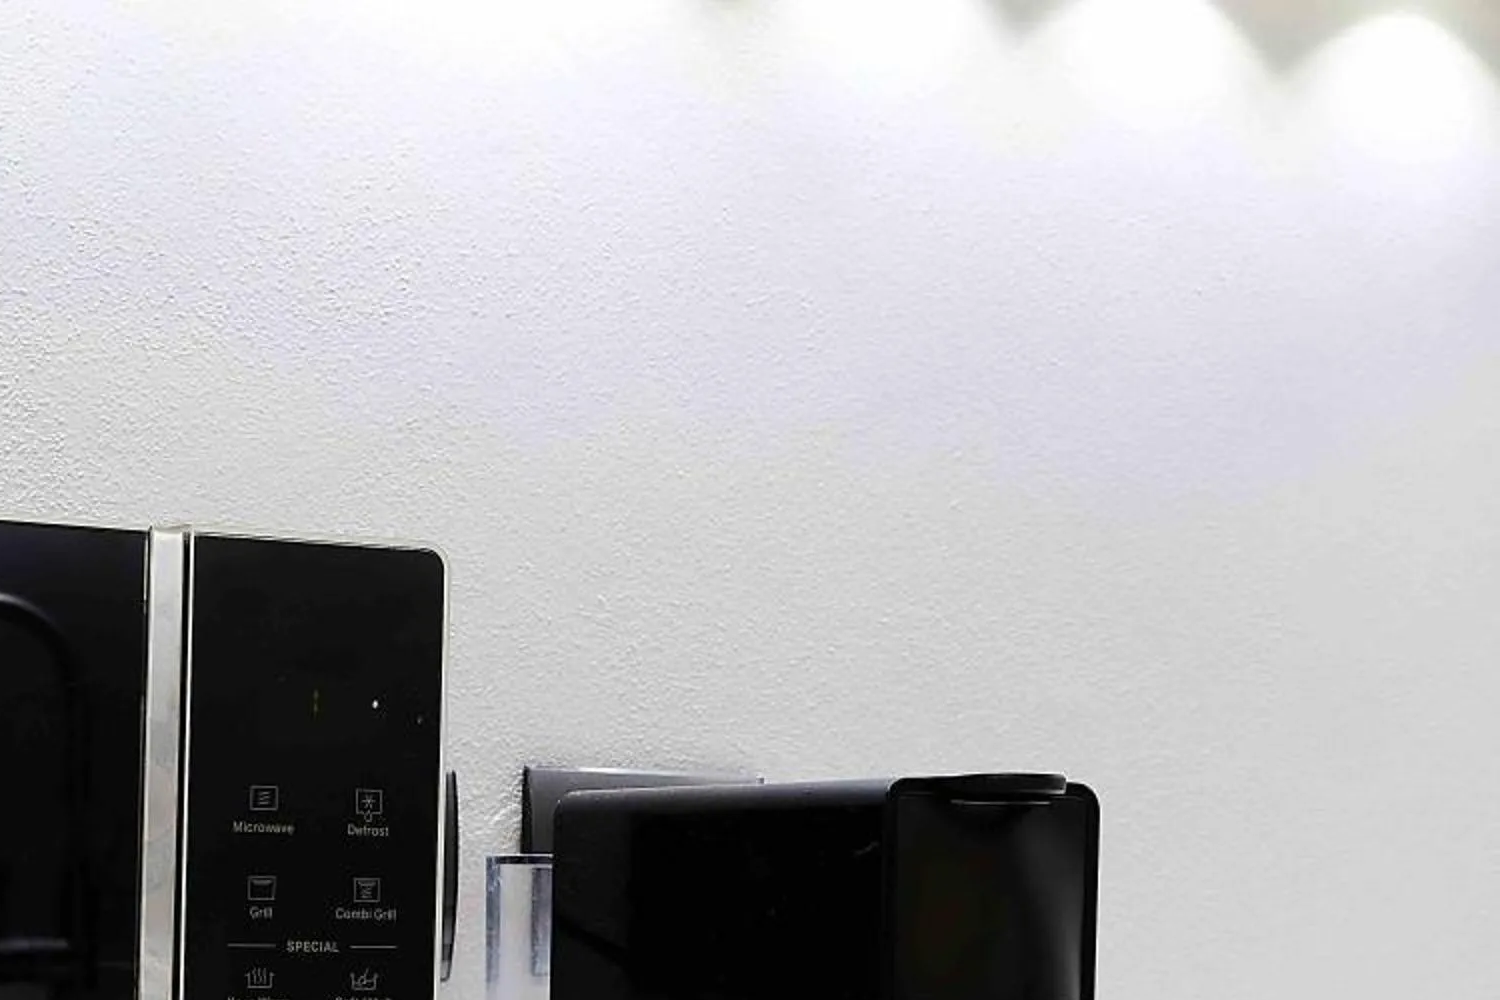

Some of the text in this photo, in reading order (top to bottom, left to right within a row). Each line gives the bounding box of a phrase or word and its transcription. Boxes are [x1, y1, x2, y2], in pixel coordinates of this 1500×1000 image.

[232, 820, 295, 836] Microwave
[347, 823, 389, 837] Defrost
[249, 906, 273, 919] Grill
[335, 908, 397, 921] Combi Grill
[286, 941, 339, 953] SPECIAL
